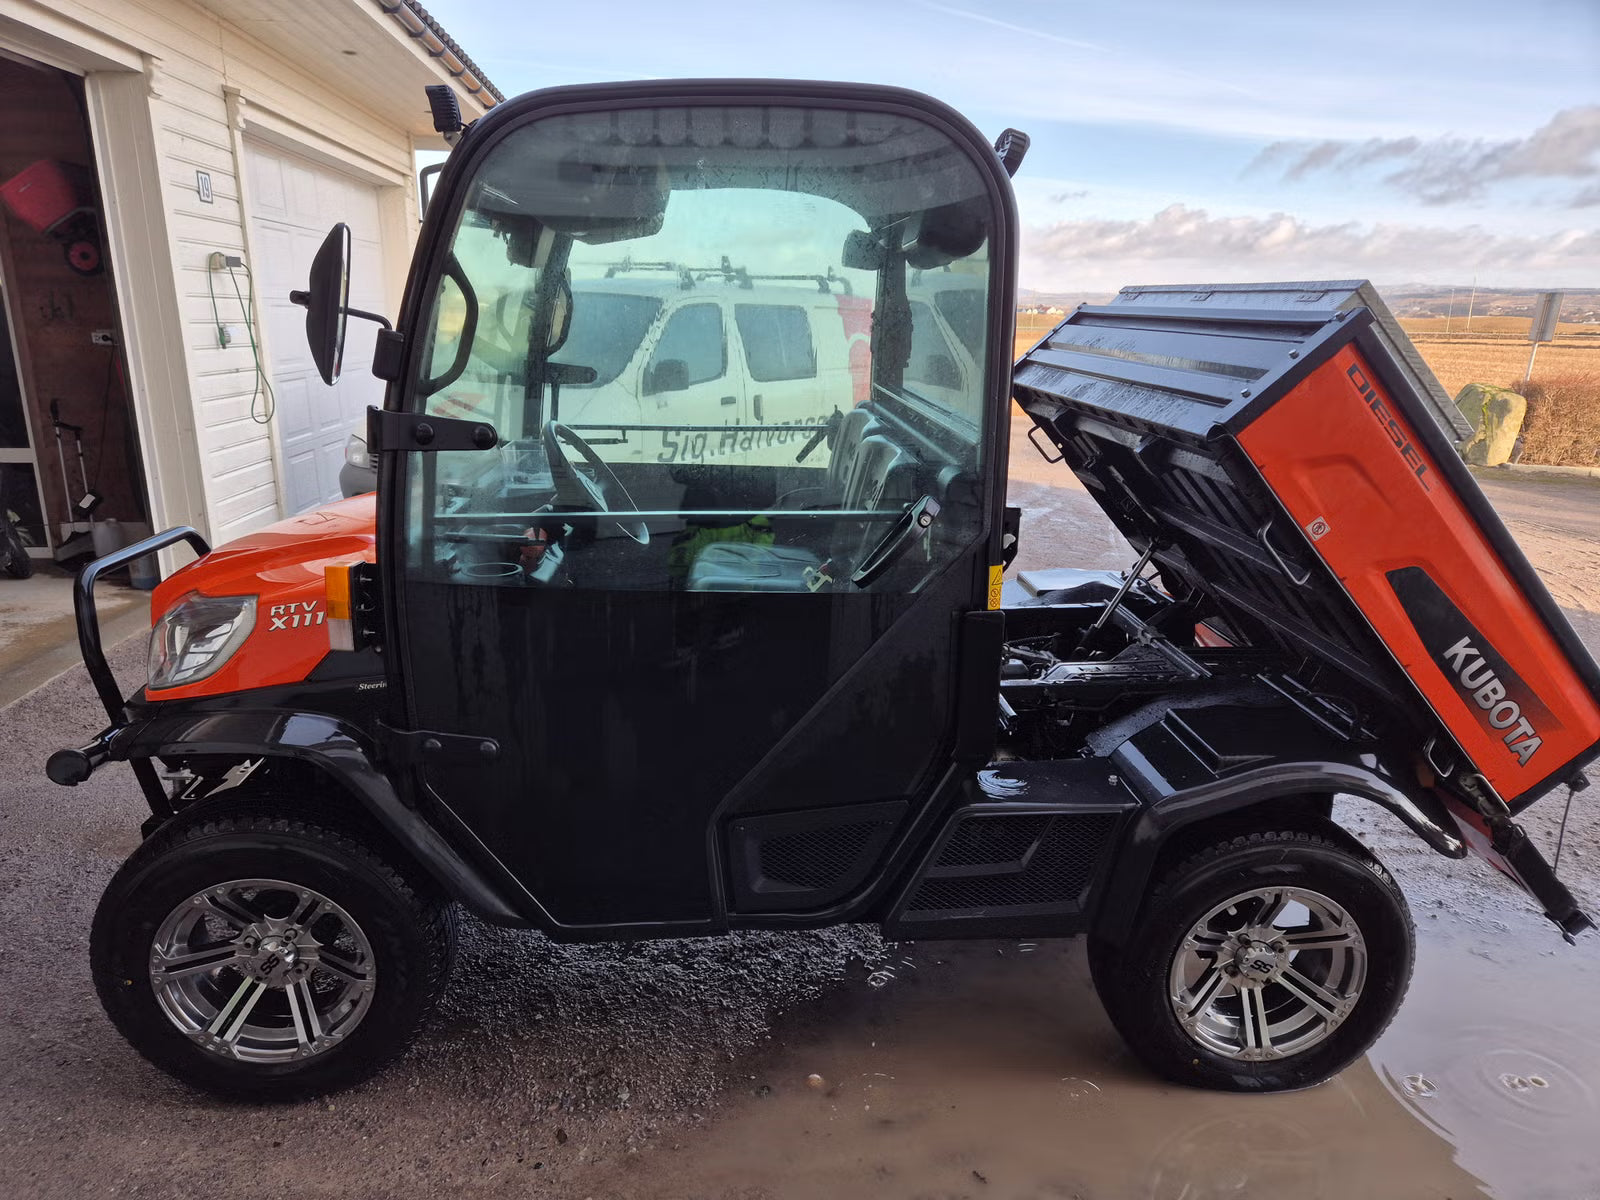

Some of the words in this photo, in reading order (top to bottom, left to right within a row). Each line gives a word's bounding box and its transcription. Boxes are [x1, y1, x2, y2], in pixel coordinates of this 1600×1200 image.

[200, 175, 210, 198] 19
[1346, 363, 1430, 491] DIESEL
[270, 599, 318, 617] RTV
[268, 611, 328, 631] X111
[1442, 635, 1544, 767] KUBOTA
